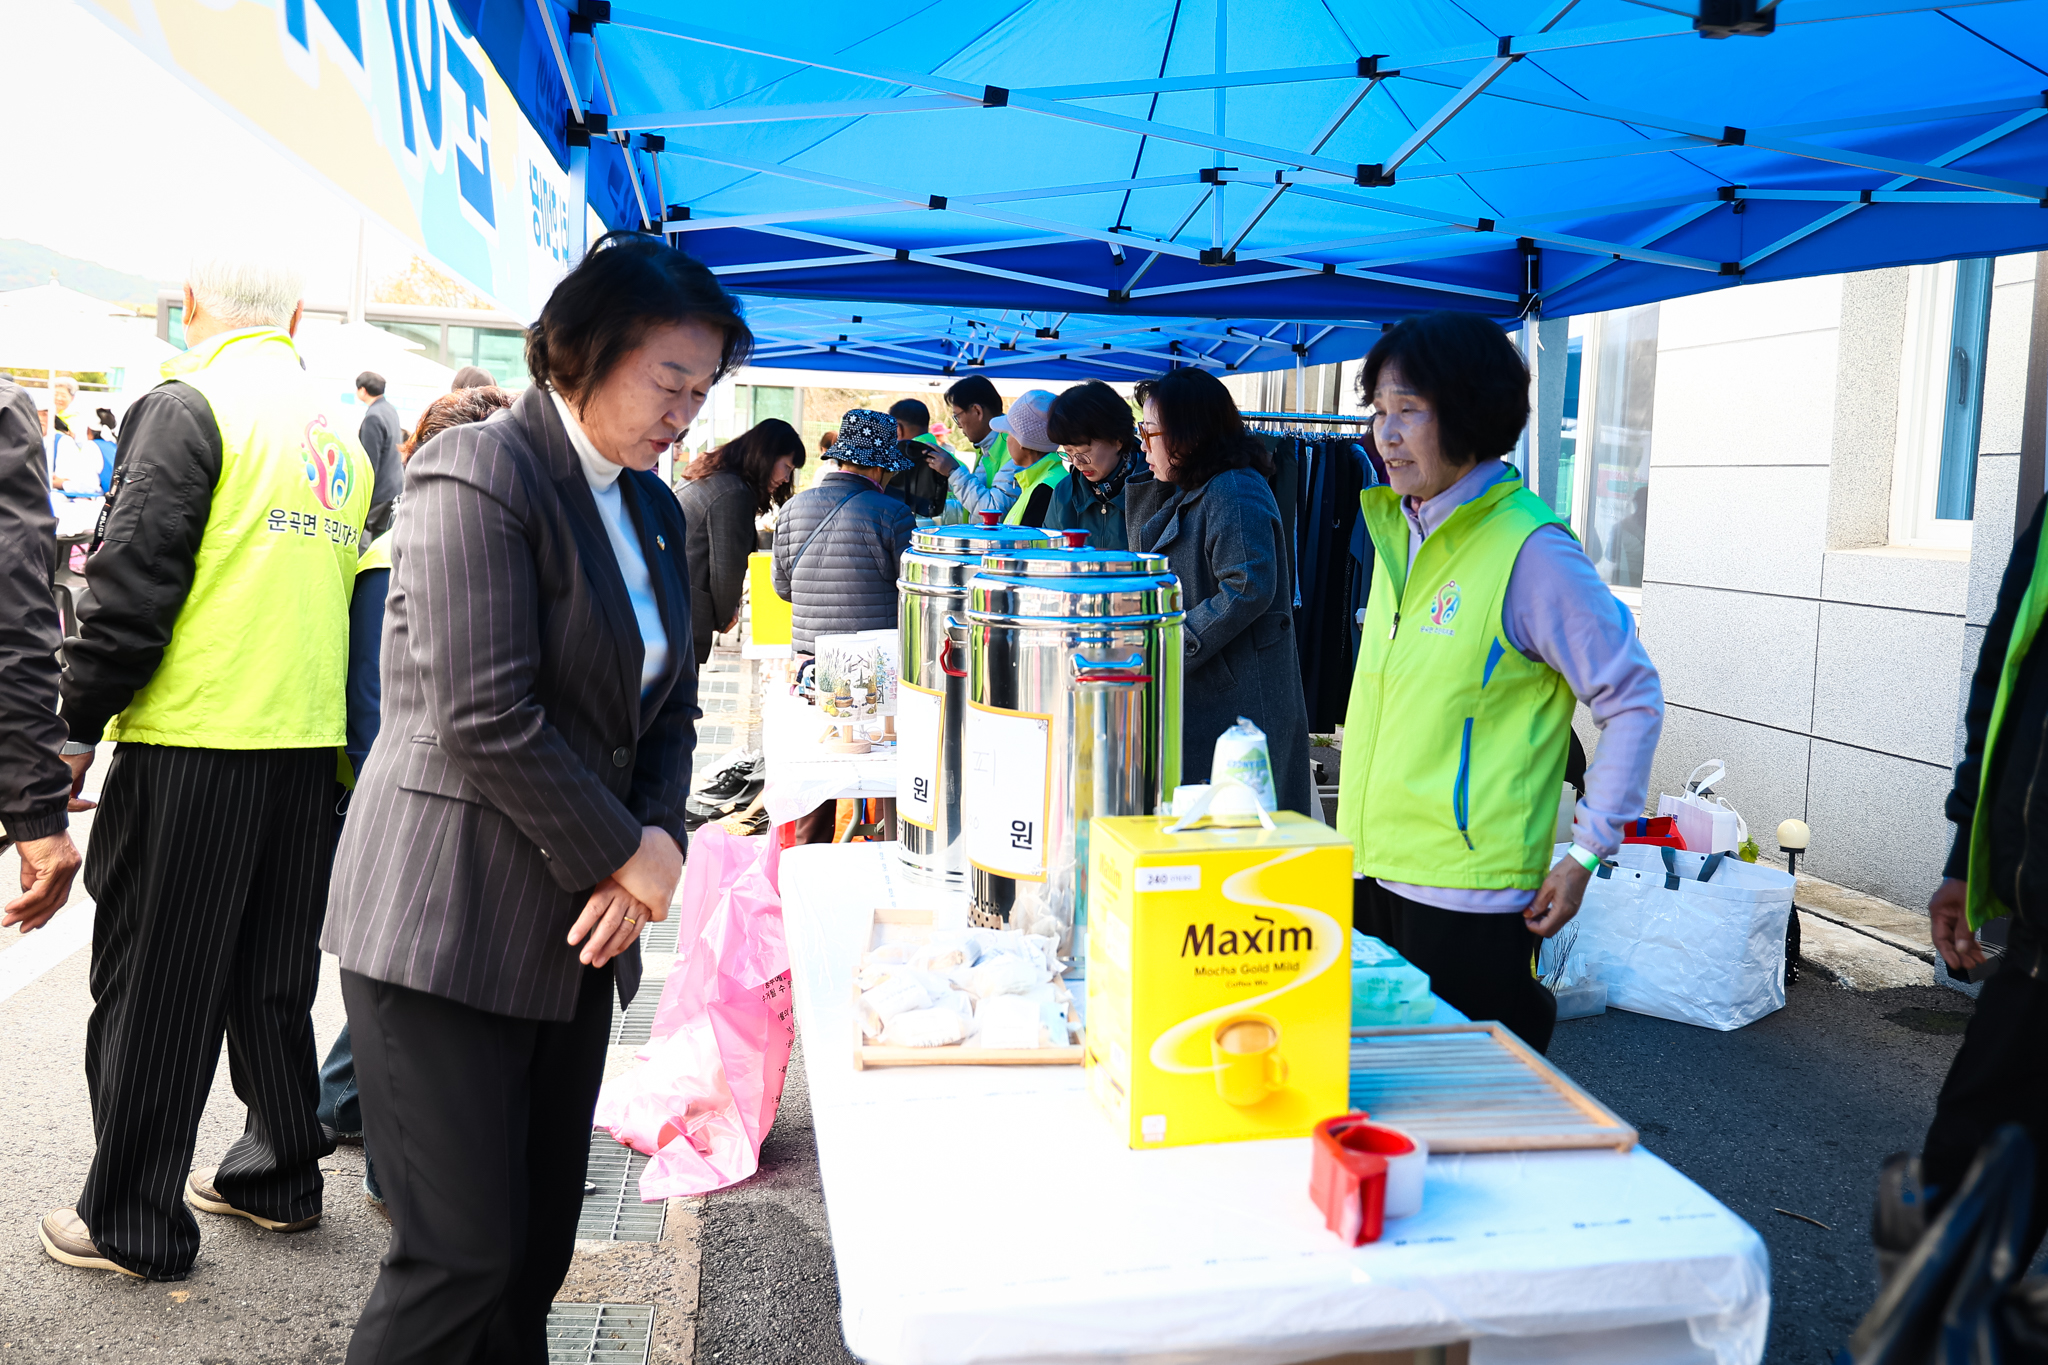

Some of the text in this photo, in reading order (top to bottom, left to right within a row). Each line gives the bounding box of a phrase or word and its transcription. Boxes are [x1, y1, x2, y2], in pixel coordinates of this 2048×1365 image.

[267, 508, 317, 537] 운곡면
[913, 776, 929, 803] 원
[1009, 819, 1034, 851] 원
[1180, 914, 1313, 958] Maxim
[1194, 961, 1301, 977] Mocha Gold Mild
